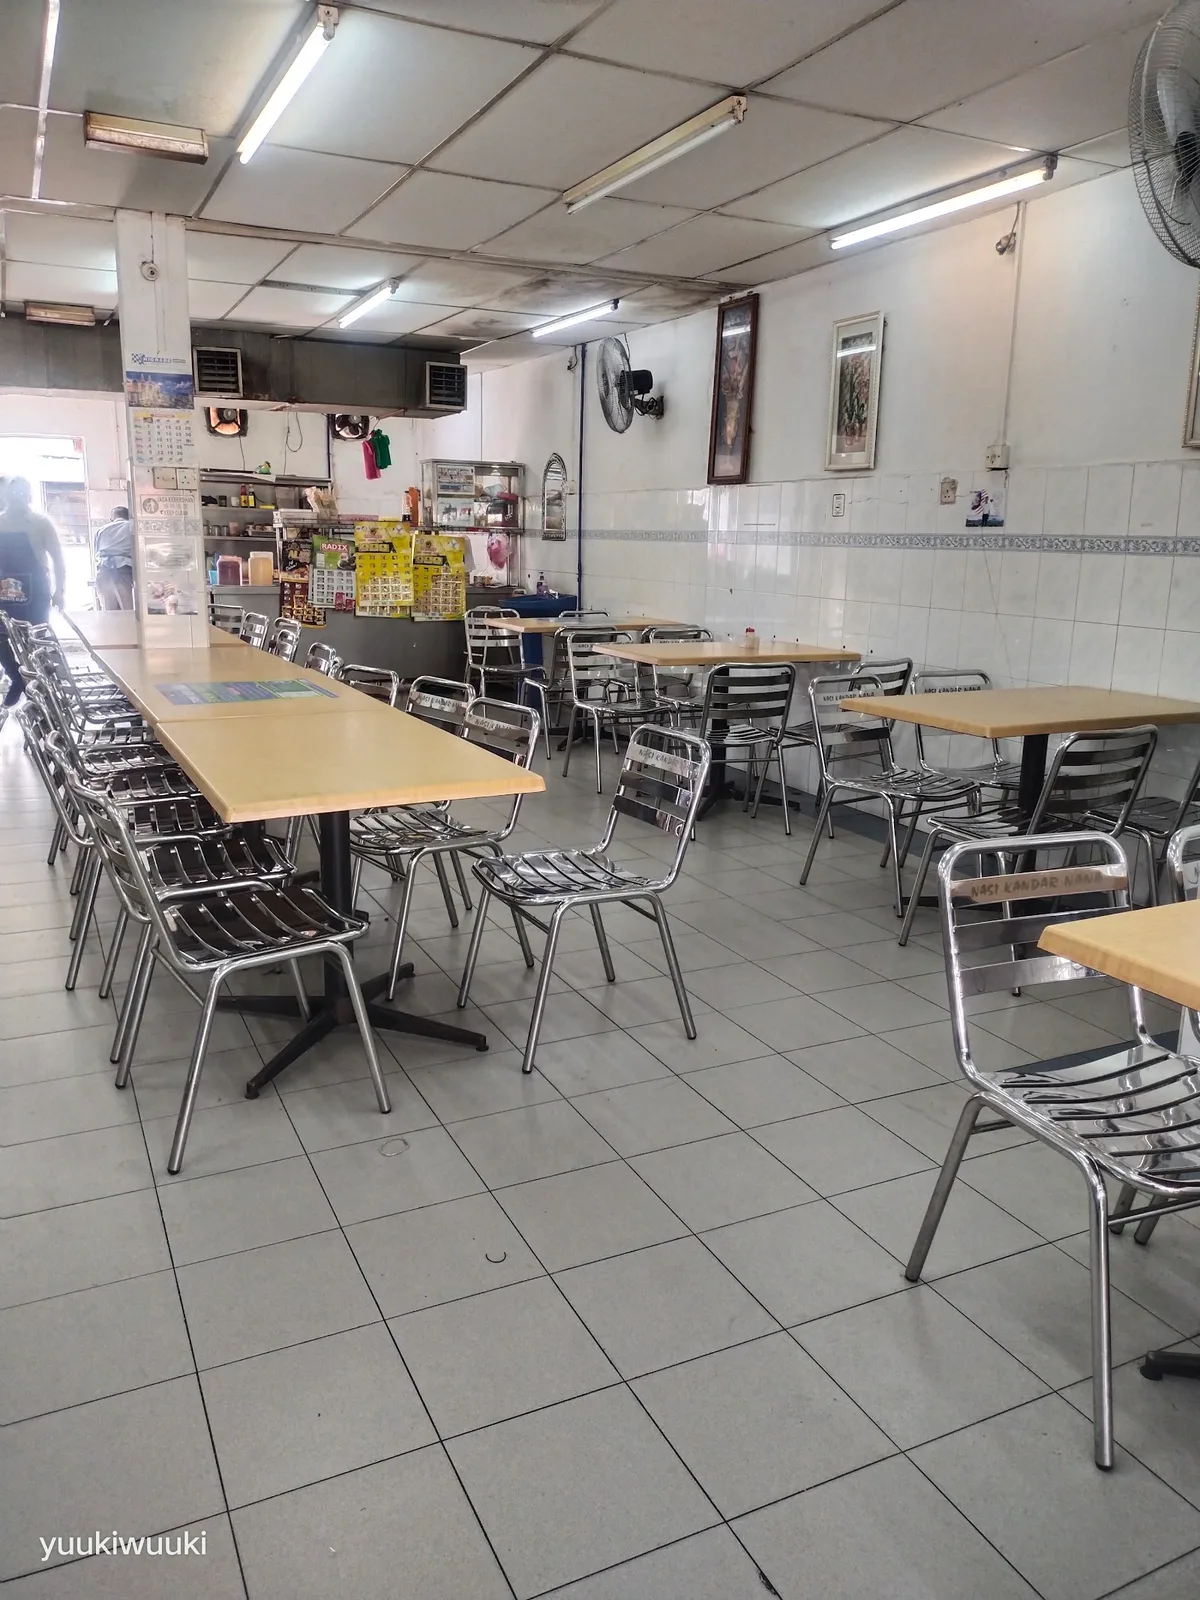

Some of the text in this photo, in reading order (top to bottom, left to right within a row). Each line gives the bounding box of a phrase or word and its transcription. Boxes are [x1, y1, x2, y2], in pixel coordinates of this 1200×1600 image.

[322, 543, 348, 551] RADIX
[971, 872, 1104, 898] NASI KANDAR NANA
